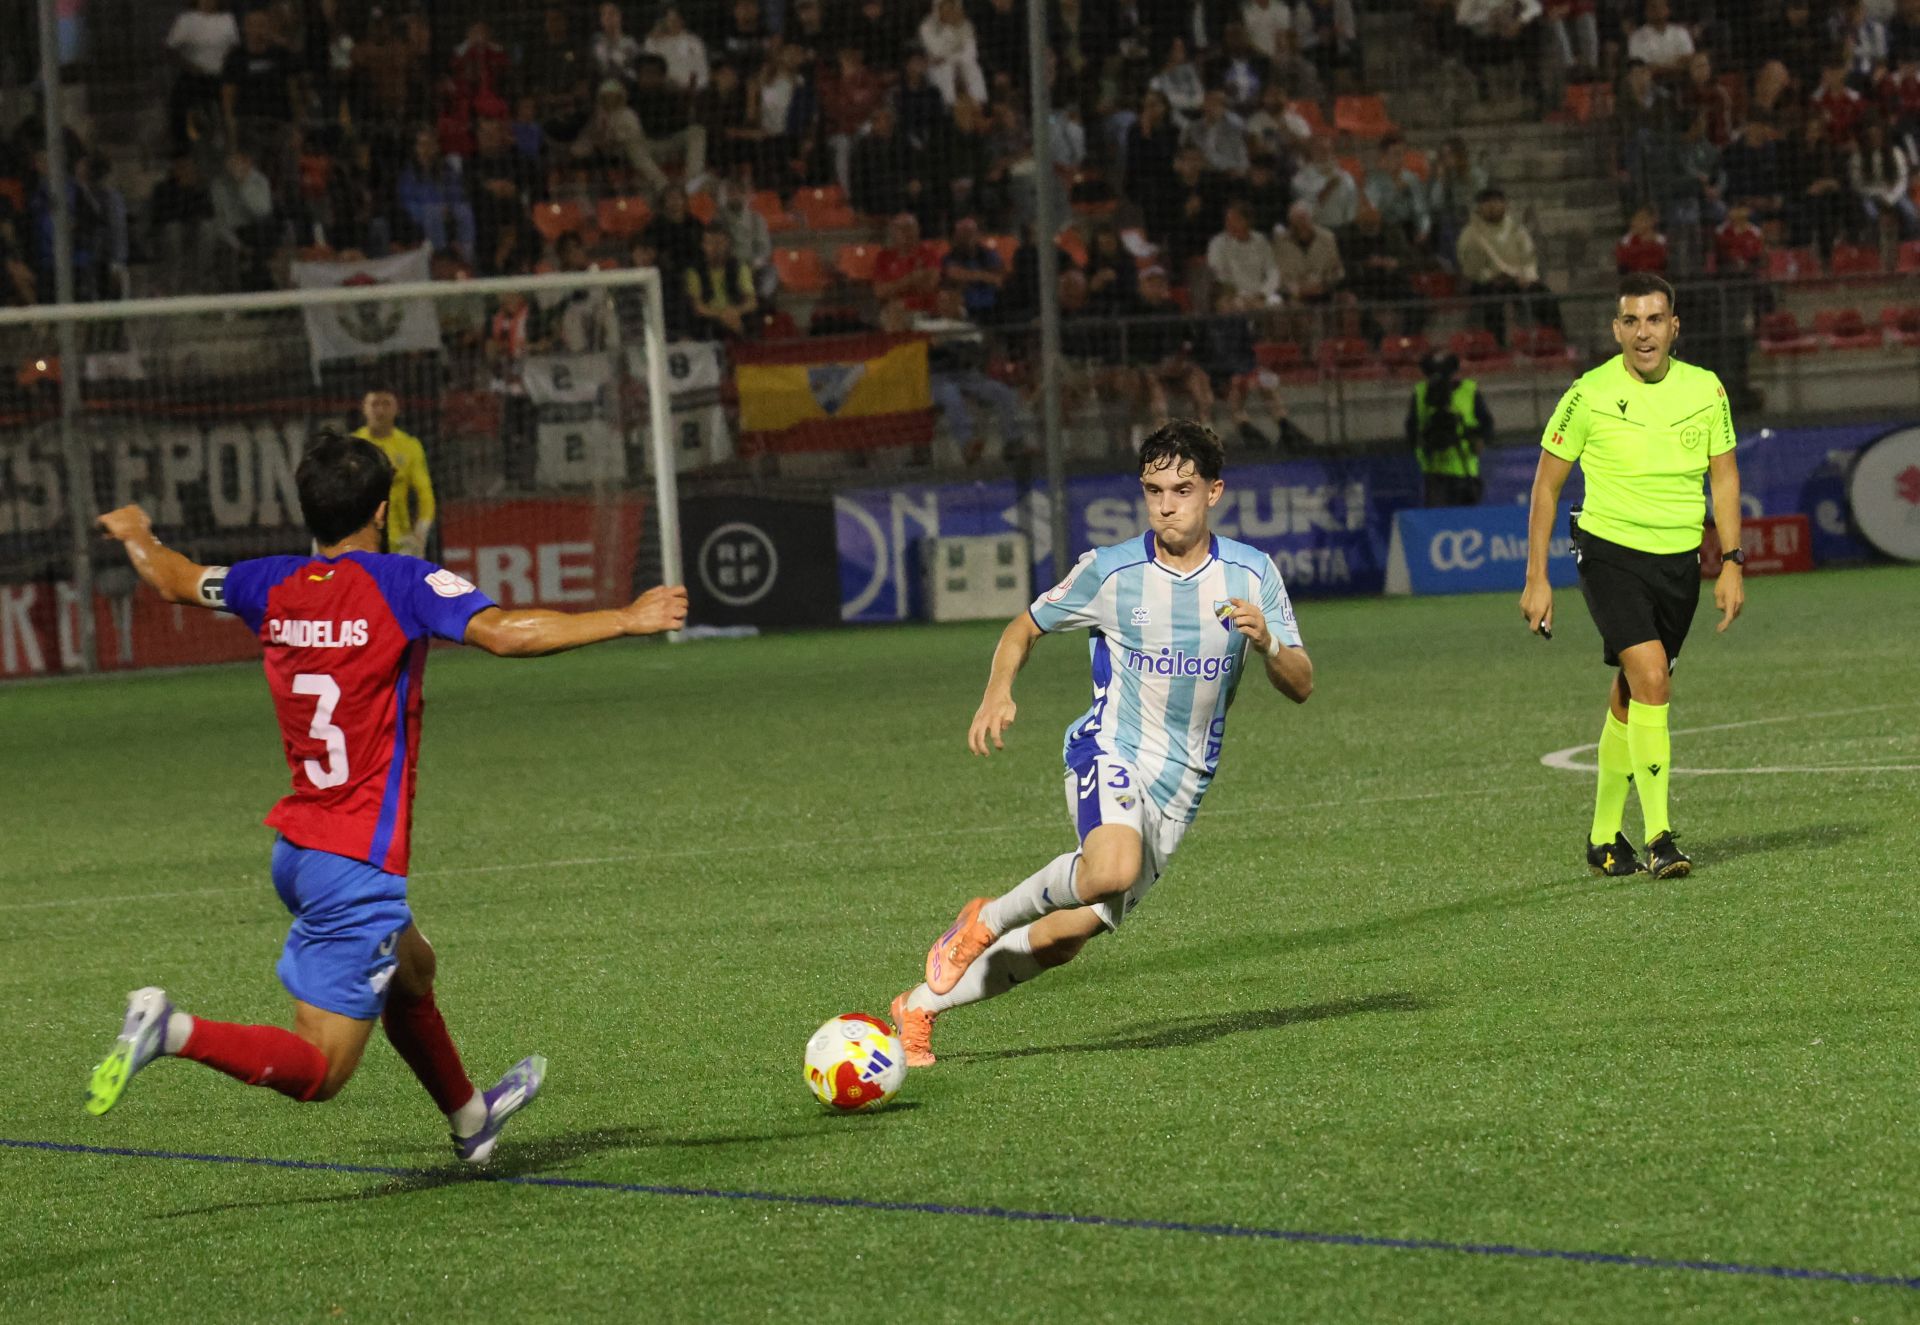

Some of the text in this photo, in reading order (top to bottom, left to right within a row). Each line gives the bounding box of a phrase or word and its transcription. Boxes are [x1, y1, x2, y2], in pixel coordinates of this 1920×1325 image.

[1084, 482, 1365, 547] SZUKI
[269, 619, 369, 648] CANDELAS
[292, 673, 349, 790] 3
[1107, 764, 1130, 789] 3
